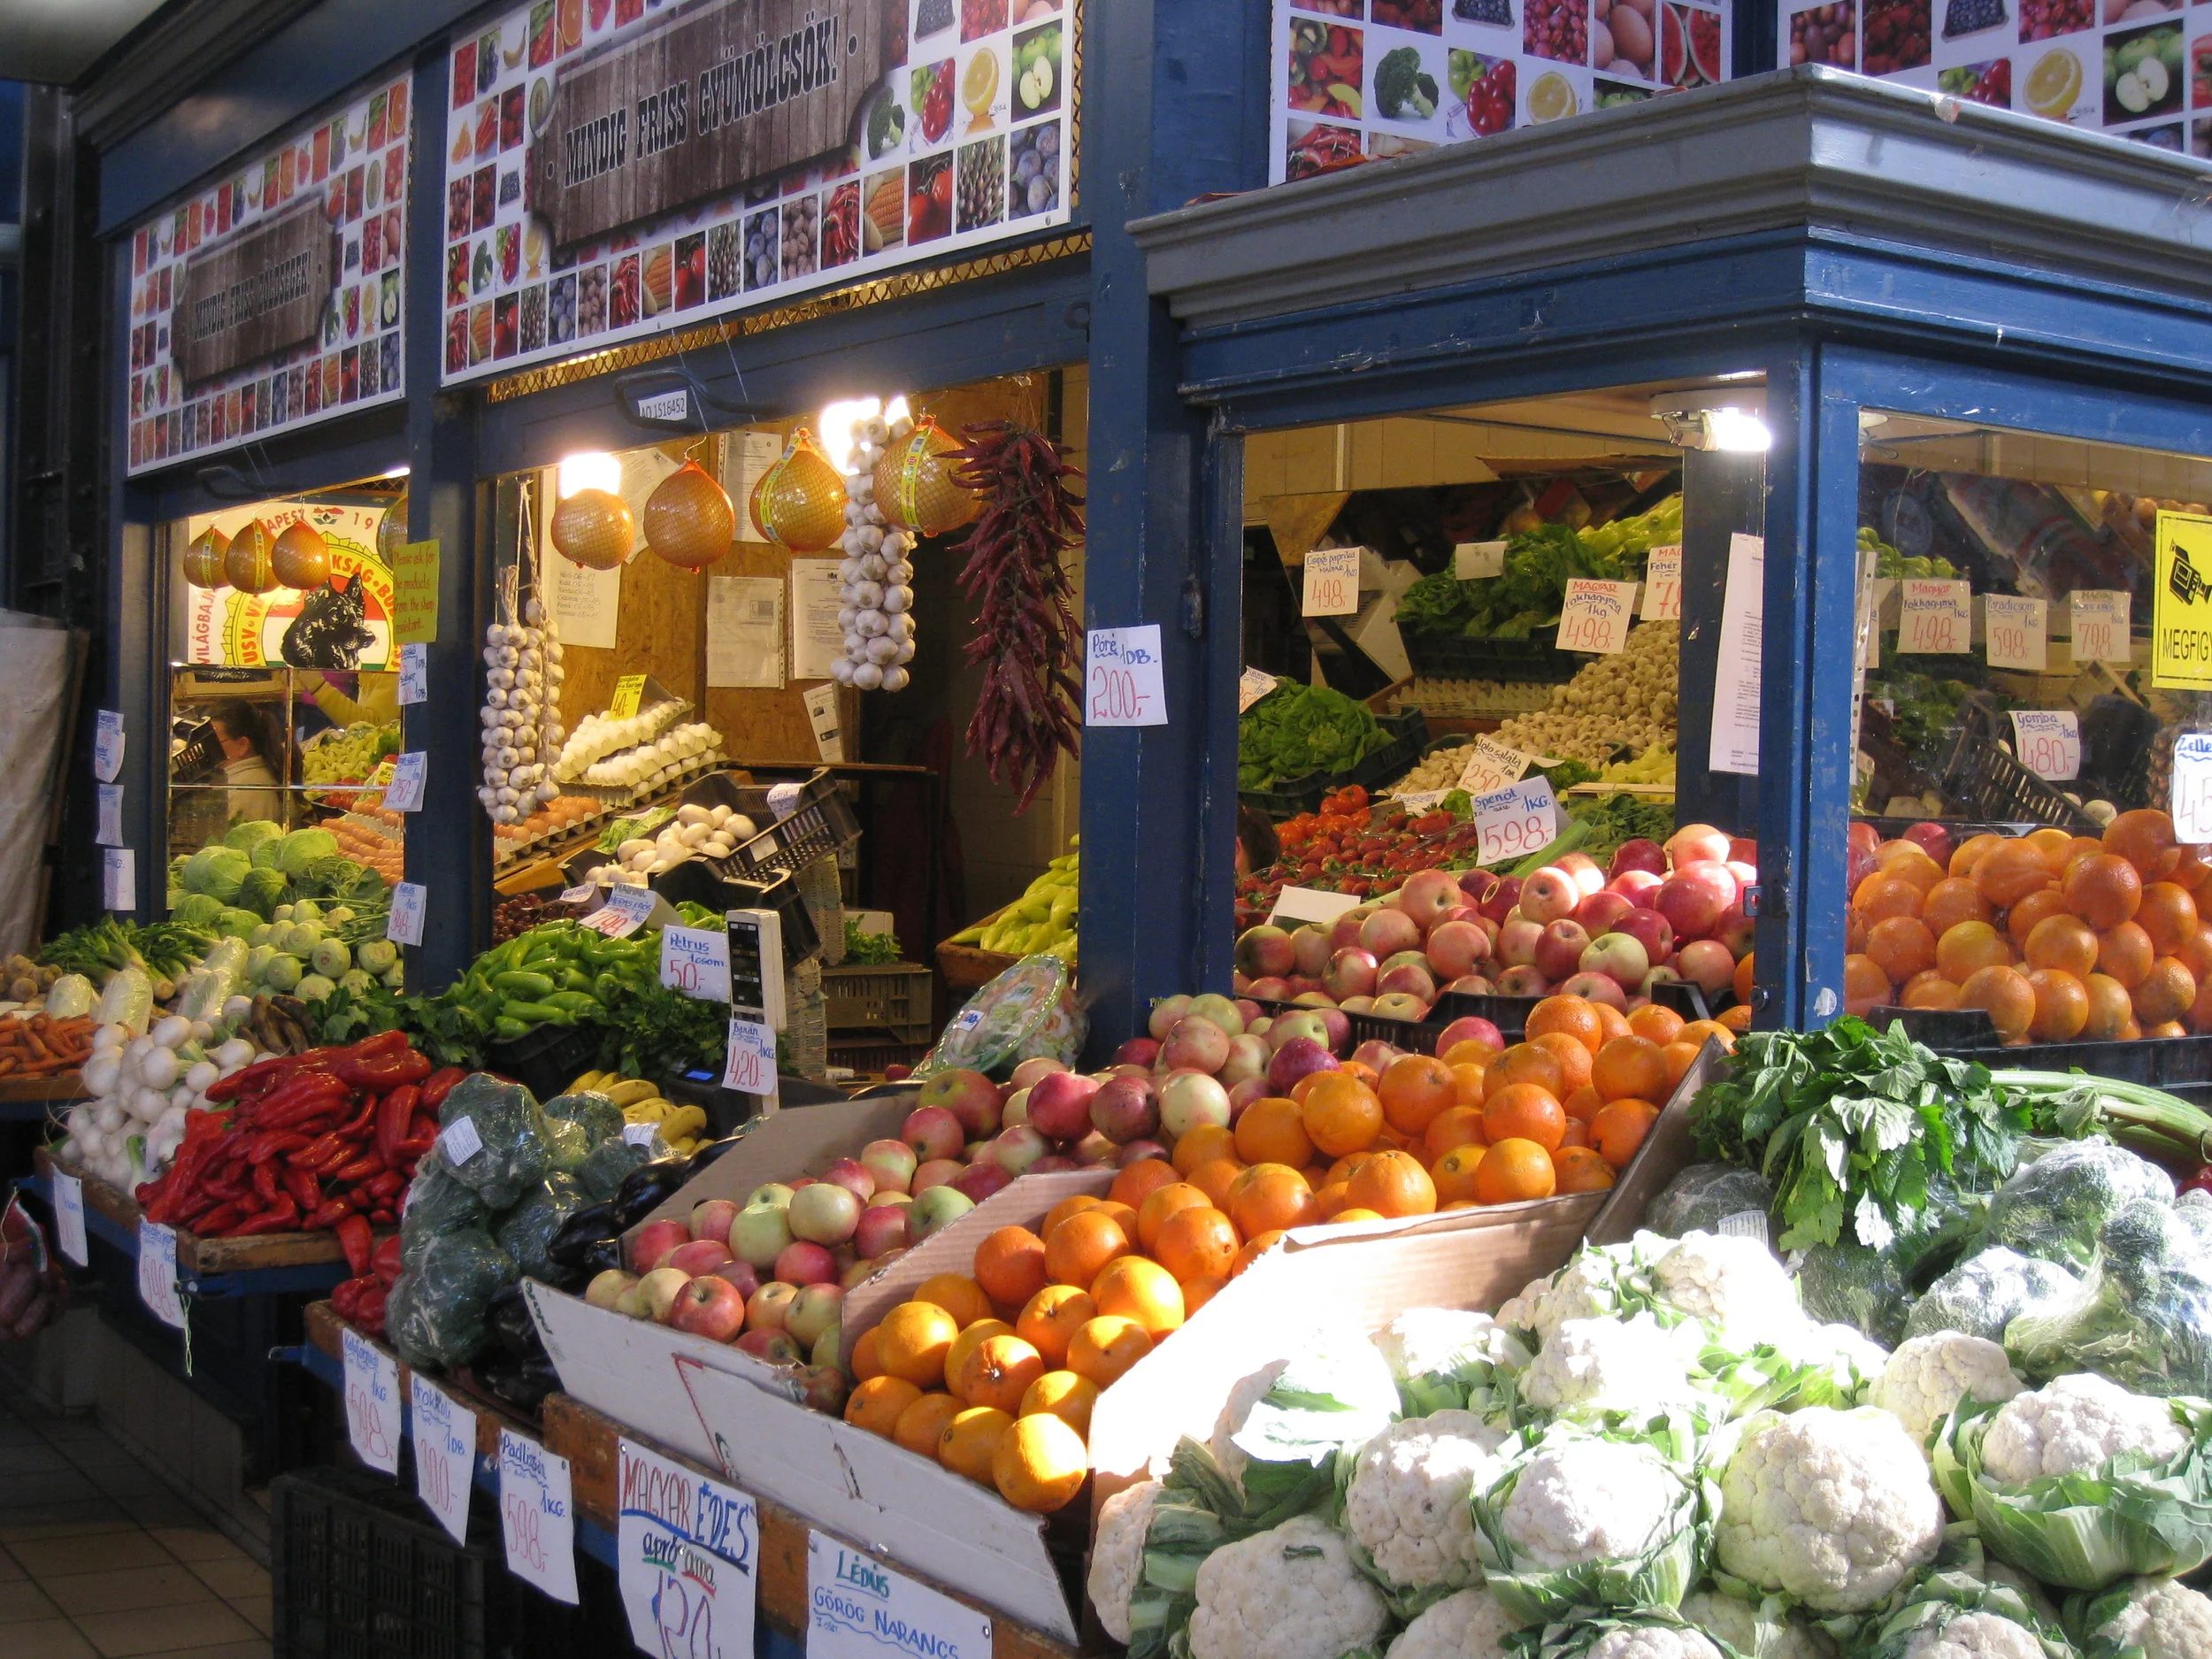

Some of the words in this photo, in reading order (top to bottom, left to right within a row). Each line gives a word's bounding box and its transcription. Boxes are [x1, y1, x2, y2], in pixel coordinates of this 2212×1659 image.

[565, 108, 627, 188] MINDIG
[636, 81, 688, 160] FRISS
[697, 11, 840, 136] GYÜMÖLCSÖK!
[1572, 580, 1617, 593] MAGYAR
[1565, 616, 1615, 649] 498,-
[1912, 615, 1958, 652] 498,-
[1093, 665, 1151, 719] 200,-
[2017, 711, 2058, 729] Gomba
[2177, 737, 2212, 754] Zelle
[1475, 788, 1517, 810] Spenót
[2179, 773, 2212, 834] 45
[1484, 816, 1553, 860] 598,-
[670, 933, 710, 952] Petrus
[729, 1046, 765, 1087] 420,-
[621, 1454, 691, 1536] MAGYAR
[814, 1586, 865, 1623] GÖRÖG
[874, 1609, 959, 1659] NARANCS
